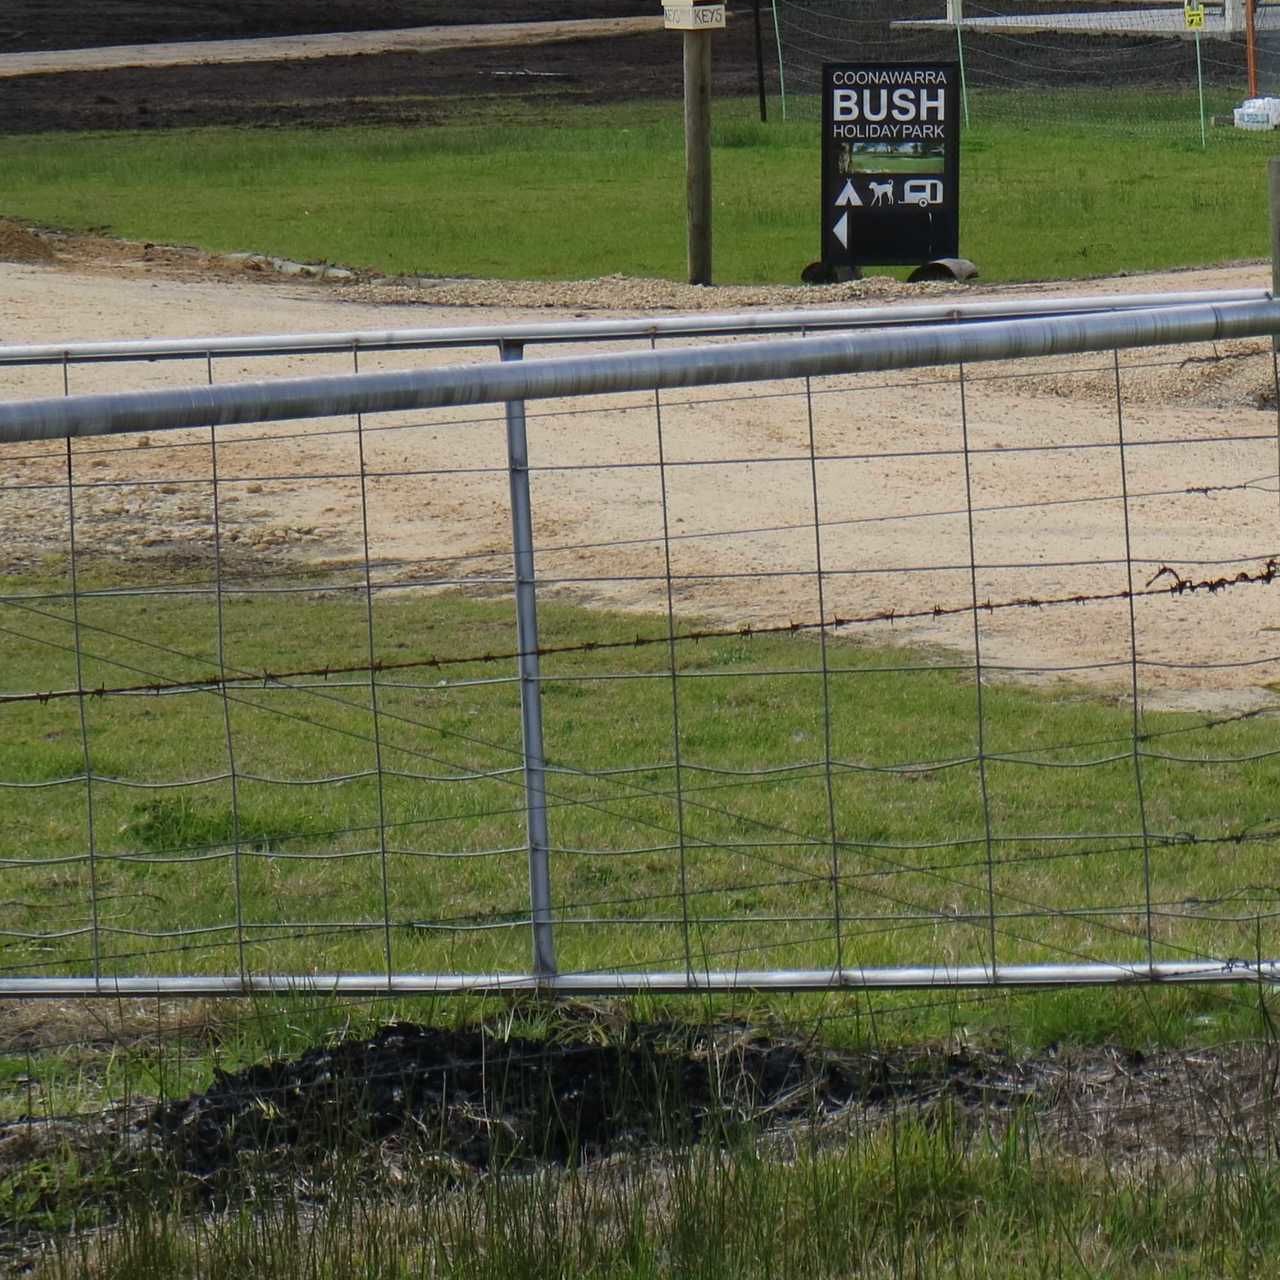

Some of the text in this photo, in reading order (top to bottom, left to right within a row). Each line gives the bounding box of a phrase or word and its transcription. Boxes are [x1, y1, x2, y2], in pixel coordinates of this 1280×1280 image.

[694, 8, 722, 24] KEYS
[832, 71, 948, 85] COONAWARRA
[833, 89, 945, 122] BUSH
[833, 125, 945, 138] HOLIDAY PARK
